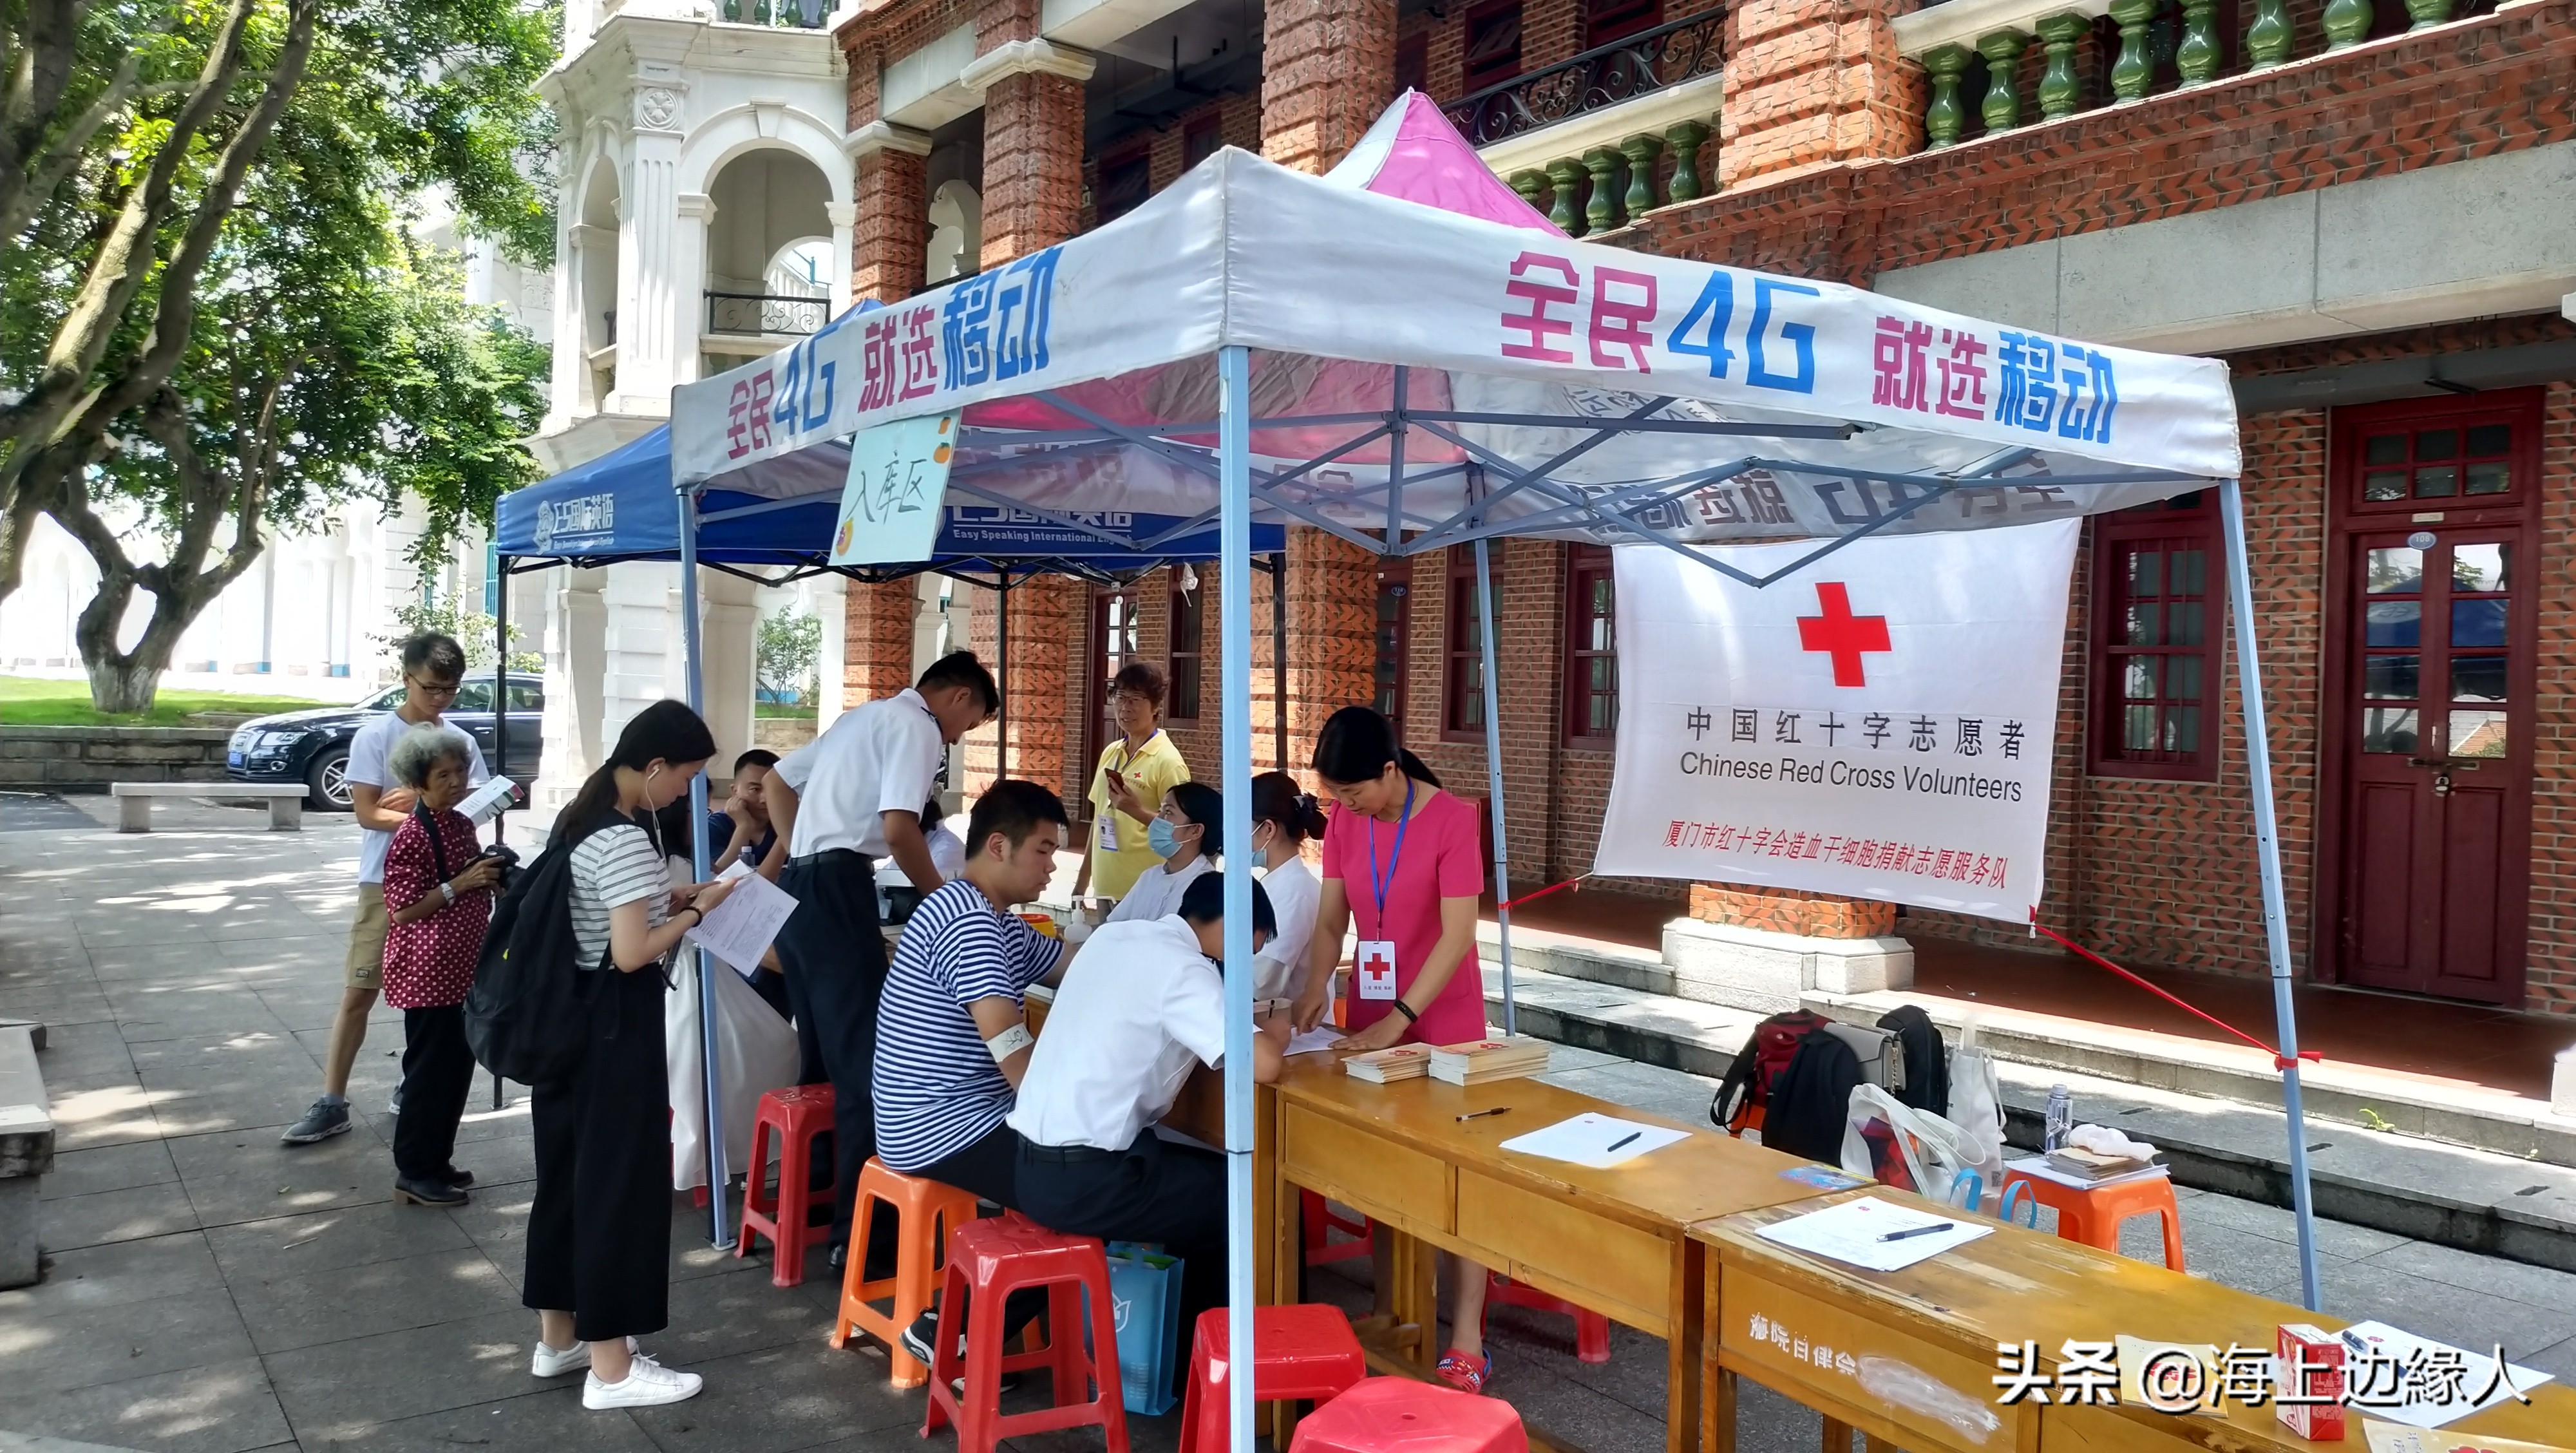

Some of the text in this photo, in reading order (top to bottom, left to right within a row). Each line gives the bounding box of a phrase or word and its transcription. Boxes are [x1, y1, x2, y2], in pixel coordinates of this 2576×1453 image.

[728, 245, 1065, 460] 全民4G 就选移动
[1501, 250, 2120, 444] 全民4G 就选移动
[953, 529, 979, 541] Easy
[982, 529, 1030, 542] Speaking
[1031, 531, 1095, 542] International
[1687, 706, 2025, 761] 中国红十字志愿者
[1680, 751, 2022, 802] Chinese Red Cross Volunteers
[1662, 819, 2009, 889] 厦门市红十字会造血干细胞捐献志愿服务队
